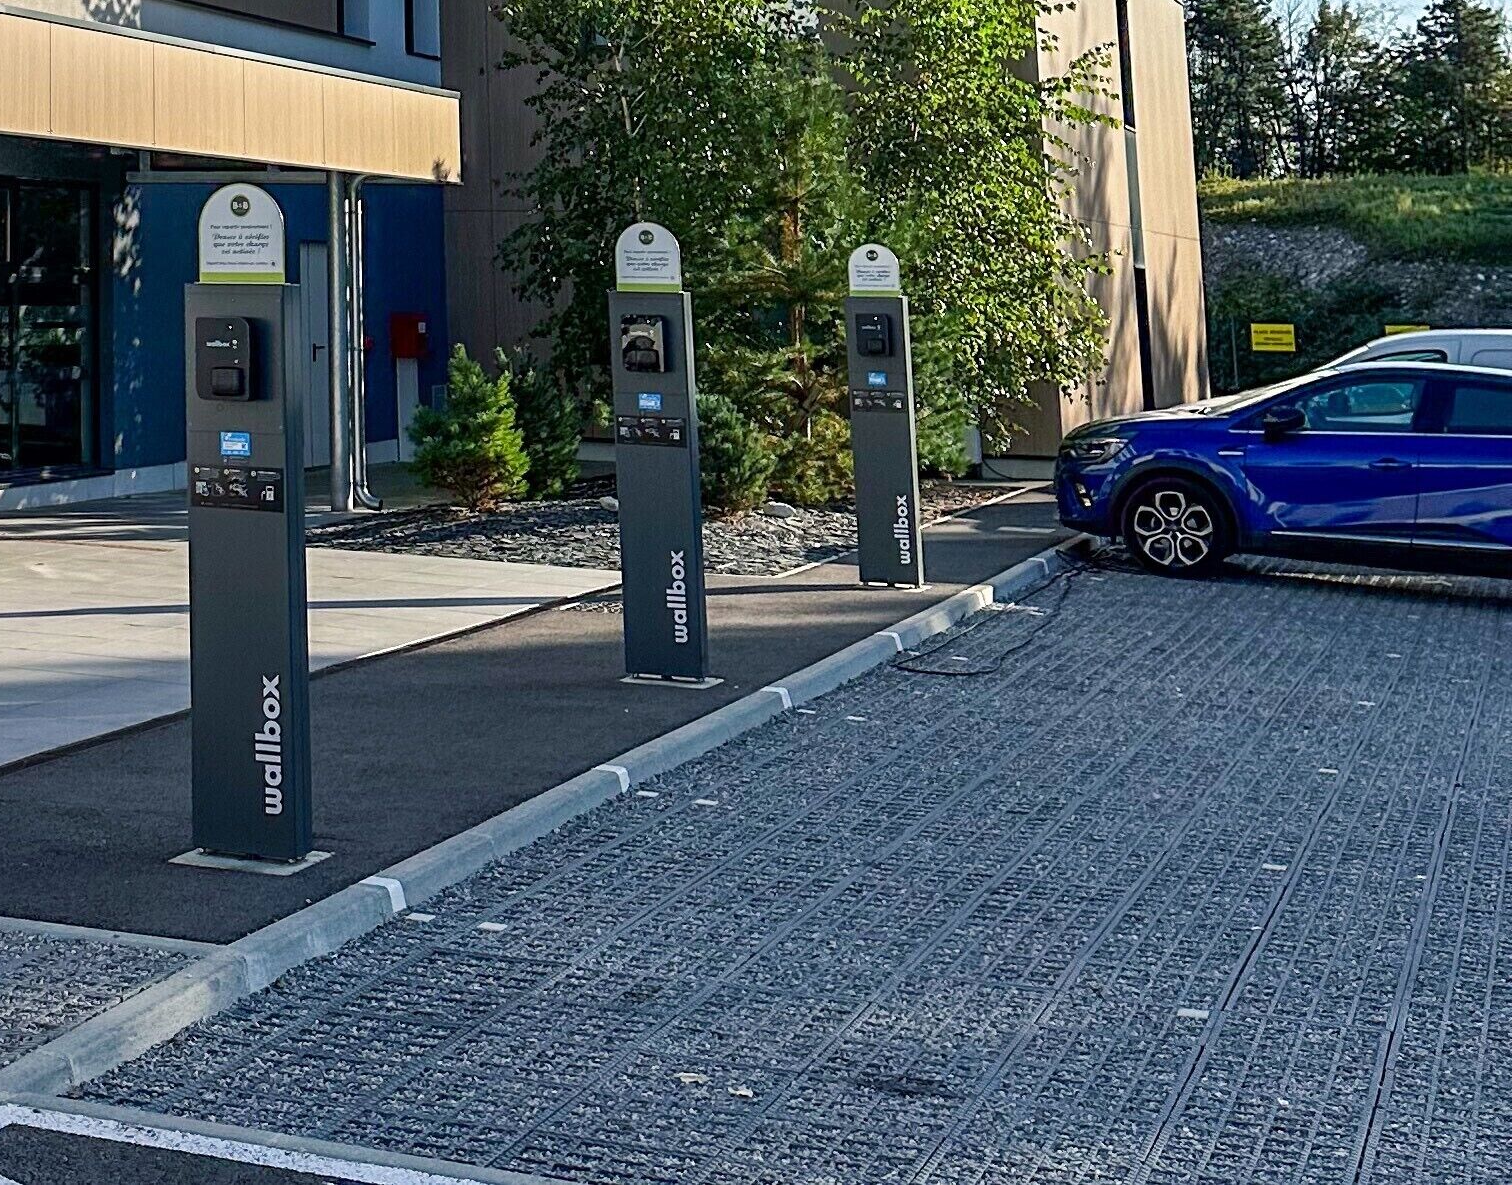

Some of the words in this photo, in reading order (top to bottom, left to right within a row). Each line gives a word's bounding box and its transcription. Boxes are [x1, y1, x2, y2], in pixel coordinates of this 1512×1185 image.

[893, 495, 911, 565] wallbox
[666, 550, 688, 643] wallbox
[254, 674, 283, 815] wallbox
